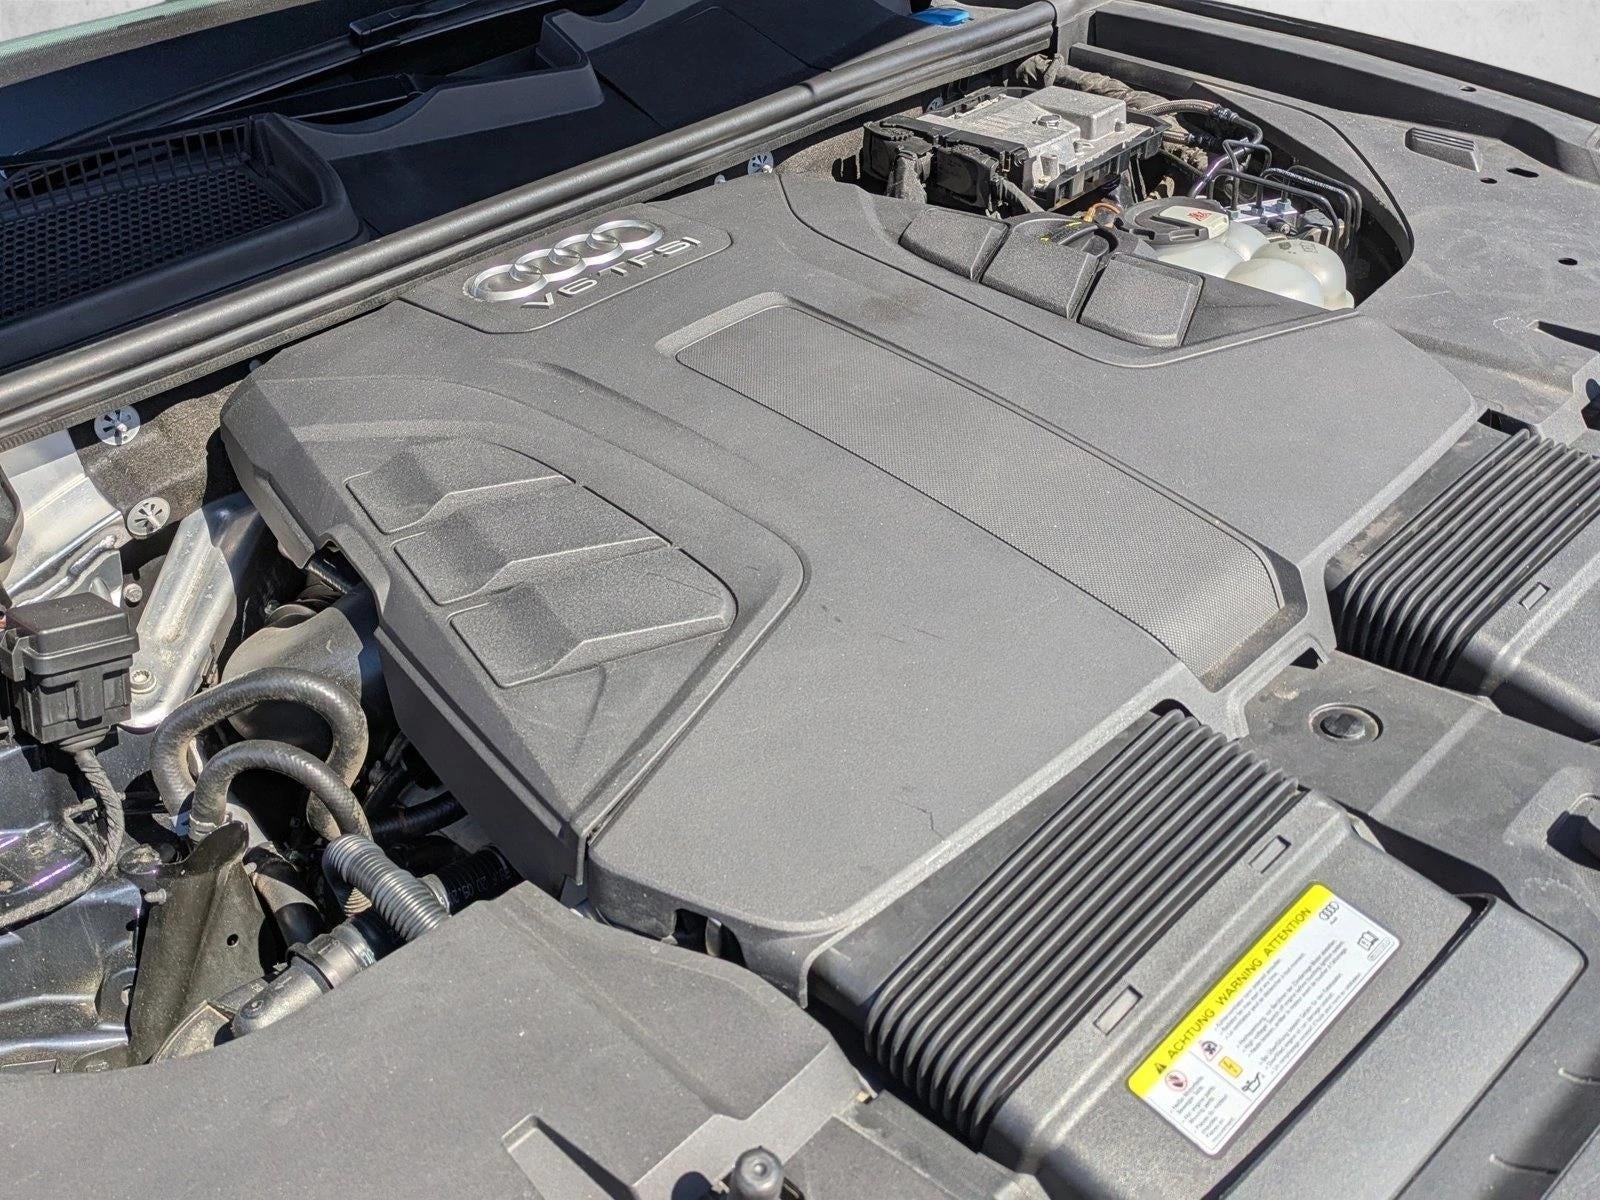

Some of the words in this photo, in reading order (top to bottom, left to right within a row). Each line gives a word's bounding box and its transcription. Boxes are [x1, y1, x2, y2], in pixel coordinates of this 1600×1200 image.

[521, 277, 598, 309] V6
[599, 236, 701, 276] TFSI
[1168, 1009, 1215, 1058] ACHTUNG
[1216, 958, 1263, 1006] WARNING
[1264, 907, 1312, 957] ATTENTION
